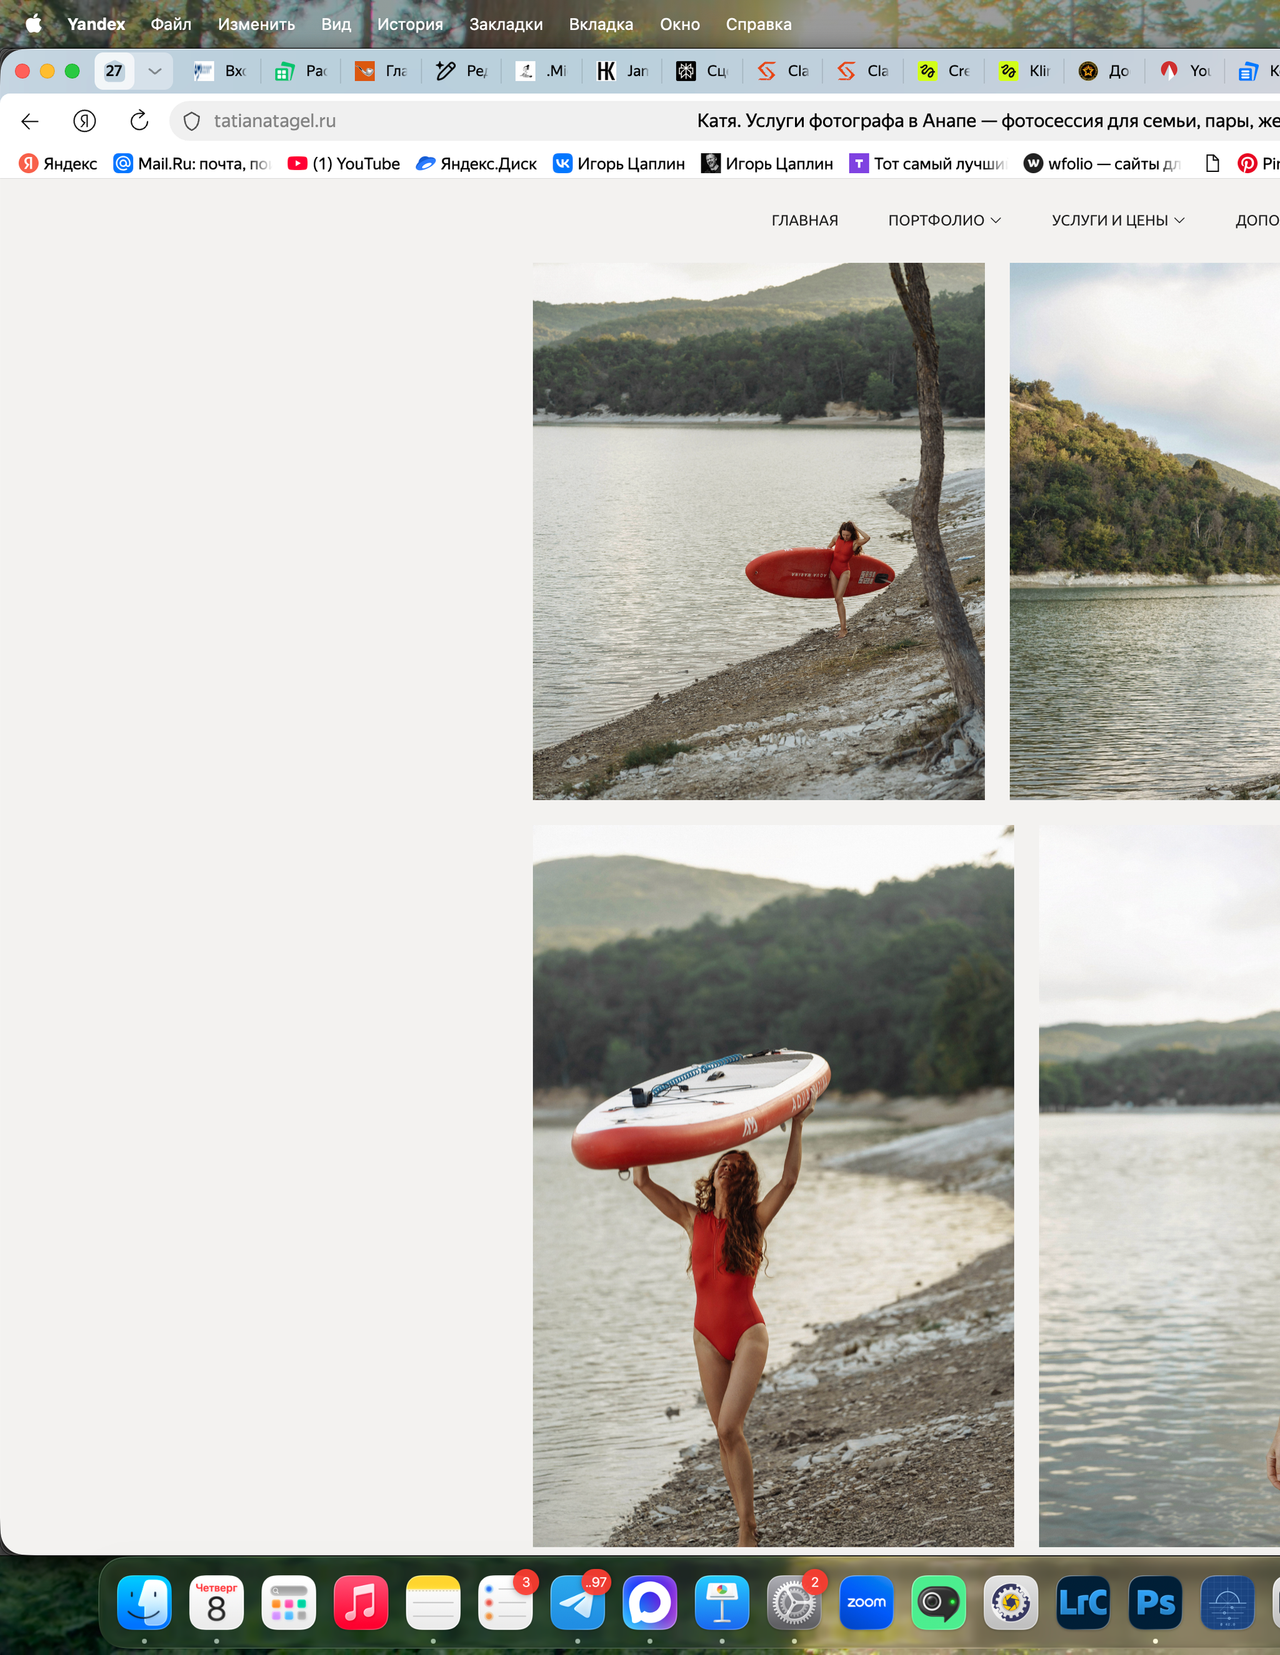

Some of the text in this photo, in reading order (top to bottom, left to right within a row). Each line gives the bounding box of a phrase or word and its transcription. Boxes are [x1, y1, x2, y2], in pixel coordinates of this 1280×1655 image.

[67, 17, 126, 31] Yandex
[151, 16, 191, 31] Файл
[218, 17, 296, 31] Изменить
[321, 17, 352, 33] Вид
[378, 17, 443, 34] История
[469, 17, 543, 33] Закладки
[570, 17, 634, 33] Вкладка
[660, 17, 701, 31] Окно
[726, 17, 792, 34] Справка
[105, 64, 123, 77] 27
[706, 64, 729, 79] Сц
[787, 64, 809, 78] Cla
[867, 64, 889, 78] Cla
[1108, 64, 1130, 80] До
[214, 112, 336, 132] tatianatagel.ru
[697, 112, 742, 129] Катя.
[745, 112, 805, 132] Услуги
[808, 112, 905, 132] фотографа
[908, 116, 919, 128] в
[922, 112, 977, 129] Анапе
[1001, 112, 1104, 132] фотосессия
[1106, 116, 1139, 131] для
[1142, 116, 1201, 130] семьи,
[1205, 116, 1254, 132] пары,
[43, 156, 98, 173] Яндекс
[138, 156, 196, 171] Mail.Ru:
[199, 159, 247, 173] почта,
[312, 156, 401, 173] (1) YouTube
[440, 156, 538, 174] Яндекс.Диск
[578, 156, 686, 174] Игорь Цаплин
[726, 156, 834, 174] Игорь Цаплин
[873, 156, 1007, 174] Тот самый лучши
[1047, 156, 1094, 171] wfolio
[1114, 156, 1160, 171] сайты
[772, 214, 839, 227] ГЛАВНАЯ
[888, 213, 985, 227] ПОРТФОЛИО
[1051, 214, 1169, 230] УСЛУГИ И ЦЕНЫ
[195, 1583, 238, 1594] Четверг
[522, 1576, 531, 1589] 3
[811, 1576, 819, 1589] 2
[207, 1595, 226, 1622] 8
[847, 1597, 886, 1608] zoom
[1060, 1588, 1108, 1616] LrC
[1137, 1588, 1176, 1616] Ps
